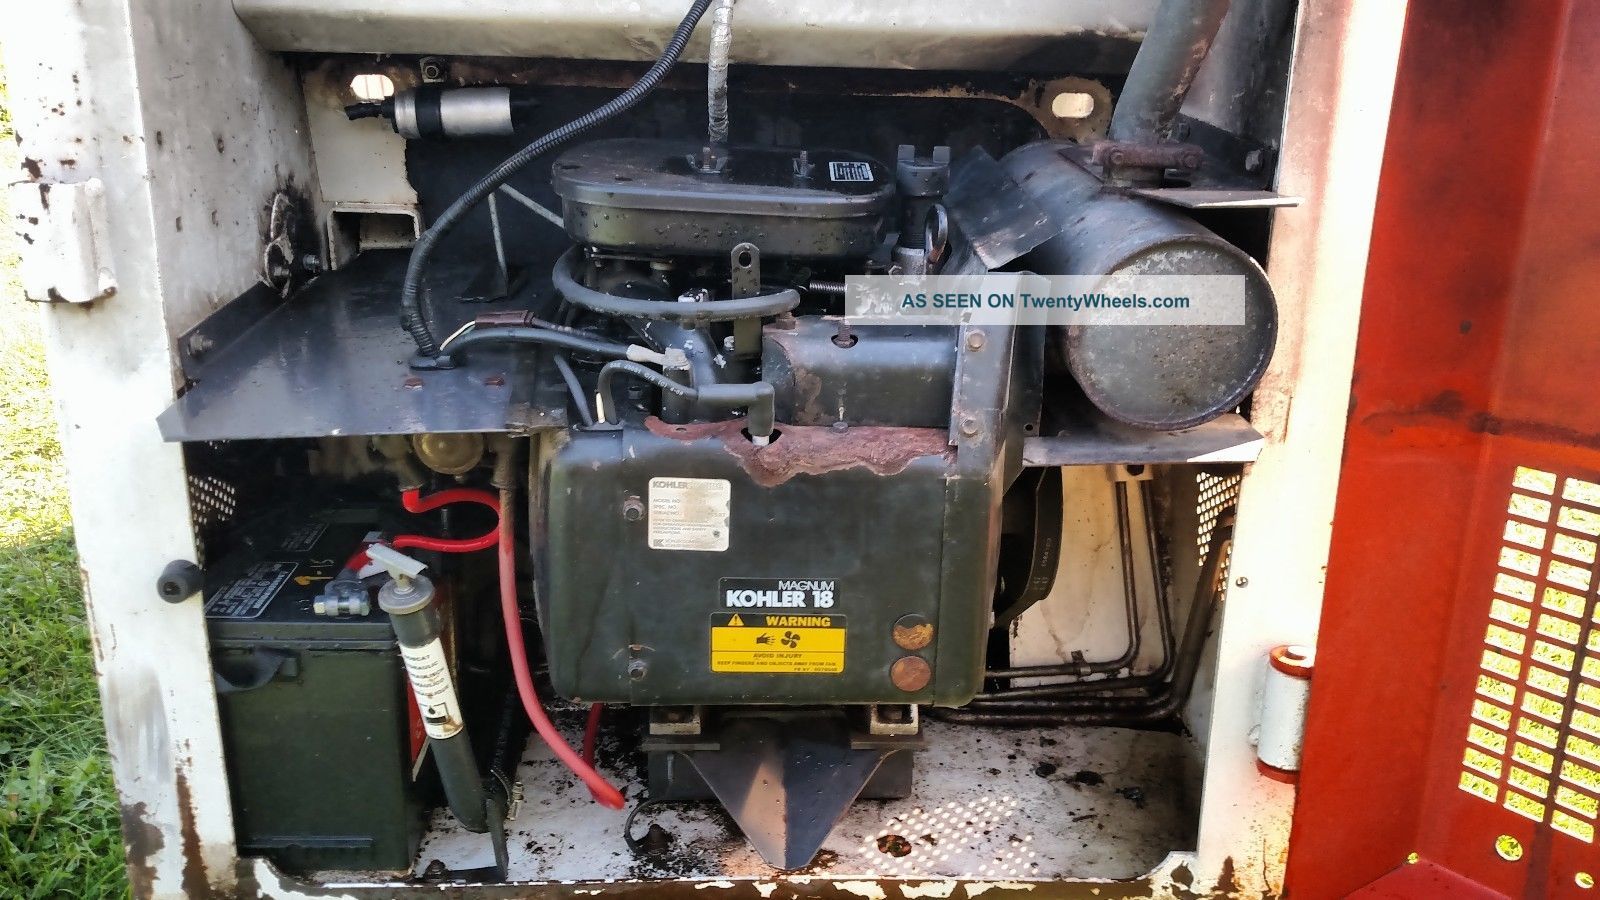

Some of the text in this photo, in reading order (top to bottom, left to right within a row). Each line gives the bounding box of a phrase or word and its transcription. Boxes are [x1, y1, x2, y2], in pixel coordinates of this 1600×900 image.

[652, 481, 688, 489] KOHLER
[778, 580, 835, 591] MAGNUM
[726, 589, 835, 608] KOHLER 18
[766, 616, 831, 627] WARNING
